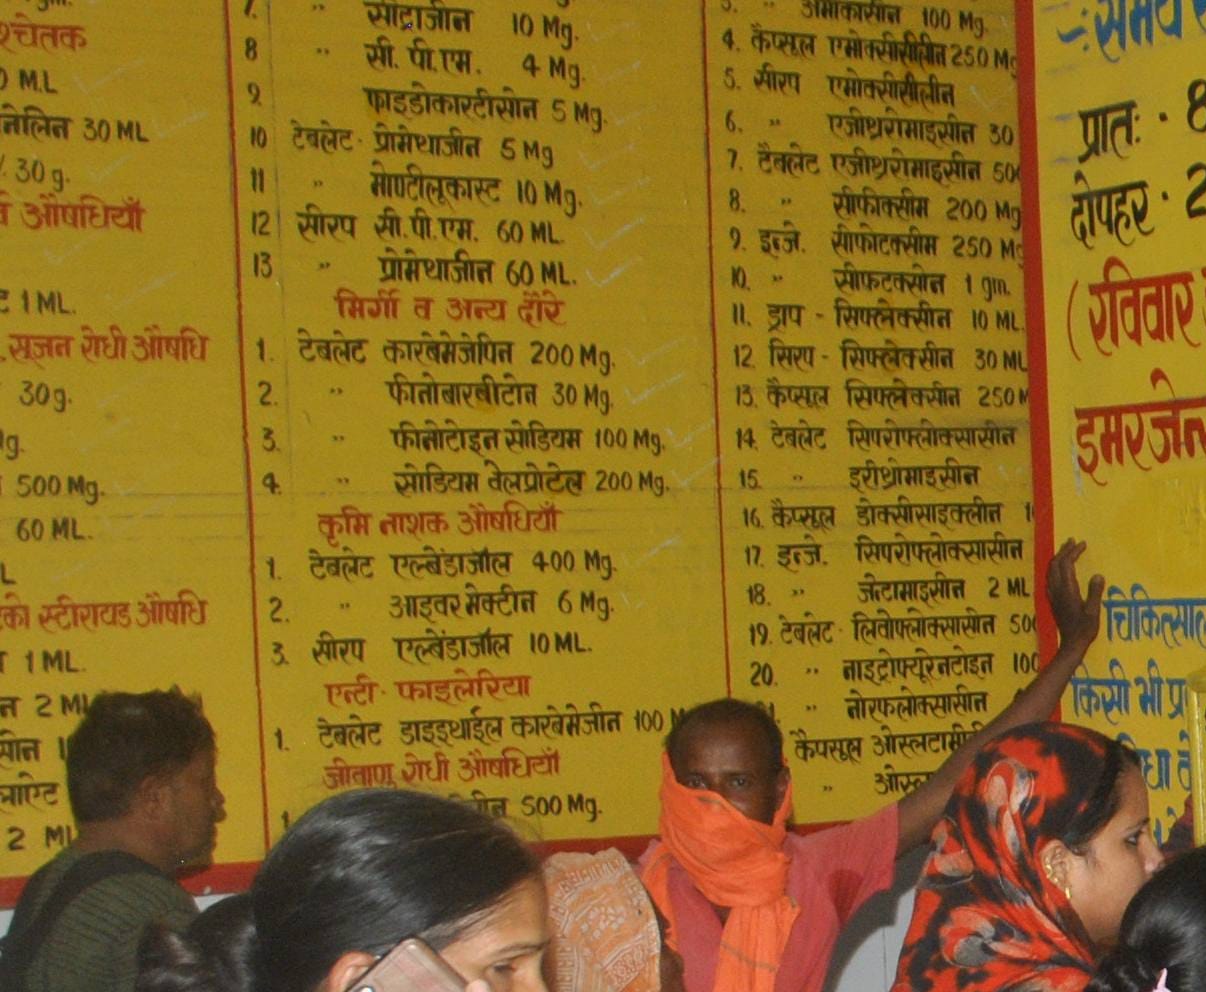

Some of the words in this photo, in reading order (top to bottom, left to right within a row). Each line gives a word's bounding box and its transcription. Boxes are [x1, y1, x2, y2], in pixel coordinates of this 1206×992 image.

[513, 13, 534, 37] 10
[923, 7, 951, 30] 100
[245, 37, 257, 61] 8
[522, 53, 540, 77] 4
[952, 45, 989, 69] 250
[552, 99, 566, 121] 5
[84, 117, 110, 142] 30
[117, 119, 149, 142] ML
[989, 122, 1013, 147] 30
[251, 126, 267, 148] 10
[501, 137, 515, 160] 5
[16, 158, 44, 182] 30
[517, 180, 537, 205] 10
[946, 197, 987, 221] 200
[1070, 170, 1155, 249] दोपहर
[252, 211, 270, 236] 12
[497, 219, 523, 243] 60
[952, 235, 992, 259] 250
[253, 252, 272, 278] 13
[506, 260, 534, 286] 60
[972, 309, 988, 331] 10
[530, 340, 575, 367] 200
[976, 349, 997, 370] 30
[19, 380, 49, 406] 30
[552, 382, 577, 406] 30
[978, 386, 1014, 408] 250
[595, 428, 628, 449] 100
[17, 474, 60, 497] 500
[595, 469, 633, 492] 200
[16, 518, 44, 541] 60
[318, 505, 372, 548] कृमि
[531, 550, 575, 572] 400
[989, 577, 999, 598] 2
[1008, 577, 1030, 597] ML
[557, 589, 572, 616] 6
[530, 632, 549, 653] 10
[35, 694, 52, 717] 2
[634, 709, 664, 732] 100
[521, 795, 562, 817] 500
